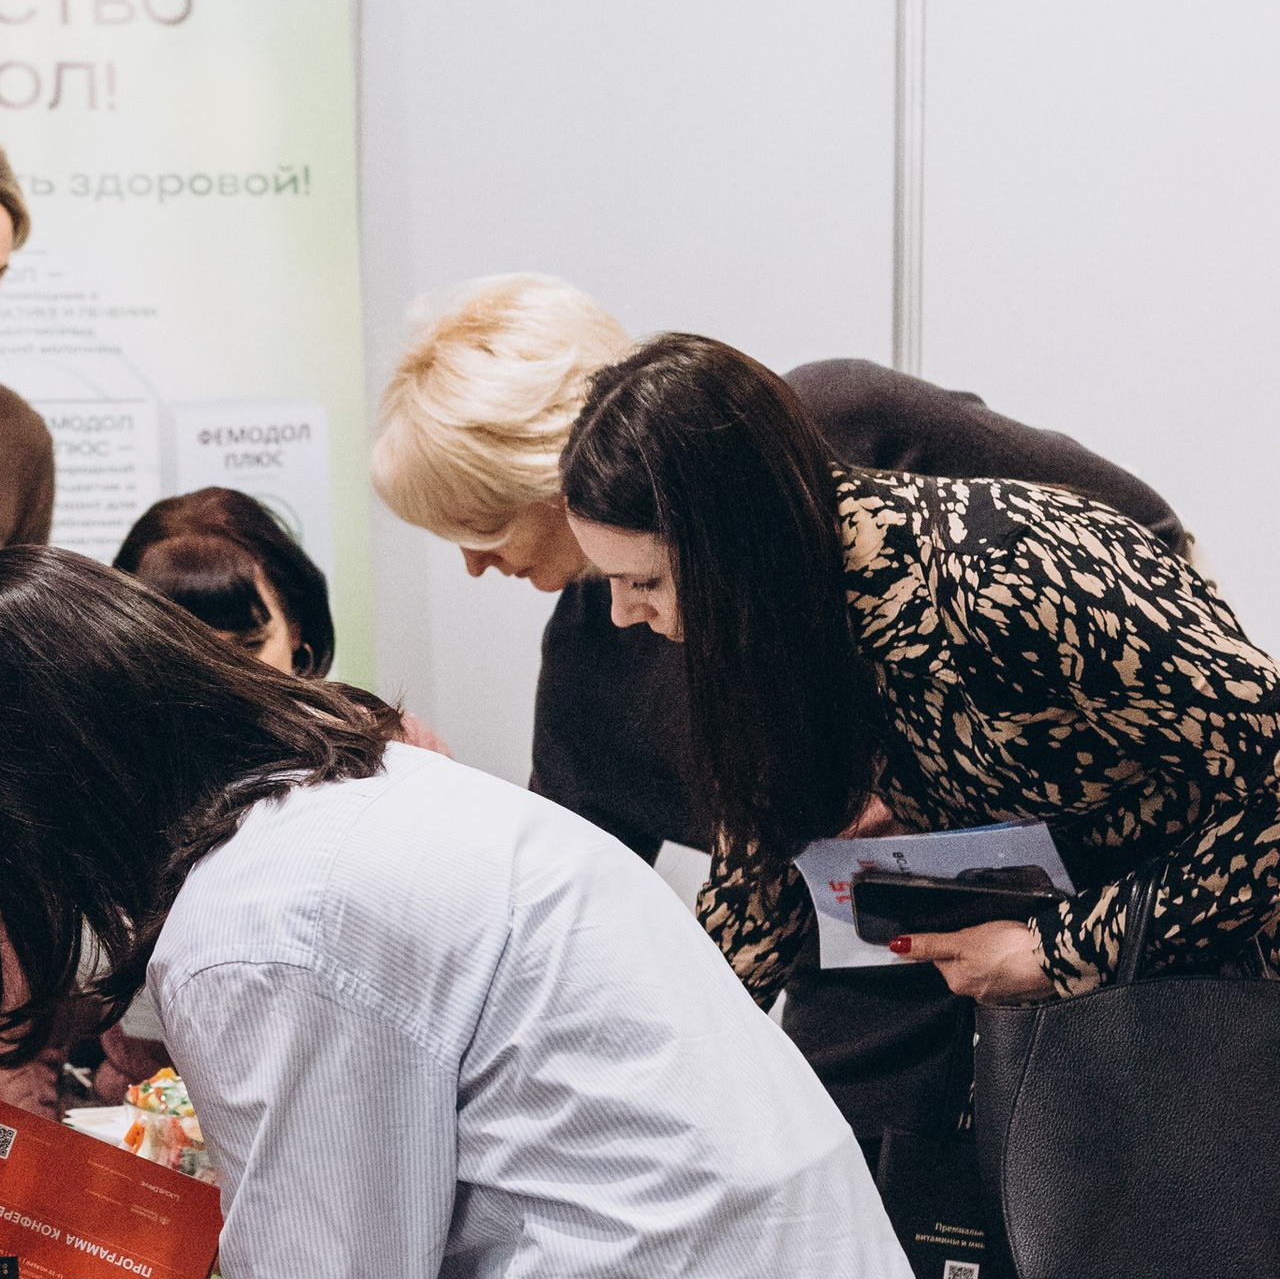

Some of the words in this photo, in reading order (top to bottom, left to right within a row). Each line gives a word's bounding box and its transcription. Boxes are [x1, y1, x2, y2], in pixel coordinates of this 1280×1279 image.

[70, 164, 312, 203] здоровой!
[197, 422, 312, 447] ФЕМОДОЛ
[224, 450, 285, 470] ПЛЮС
[66, 1233, 152, 1278] ПРОГРАММА
